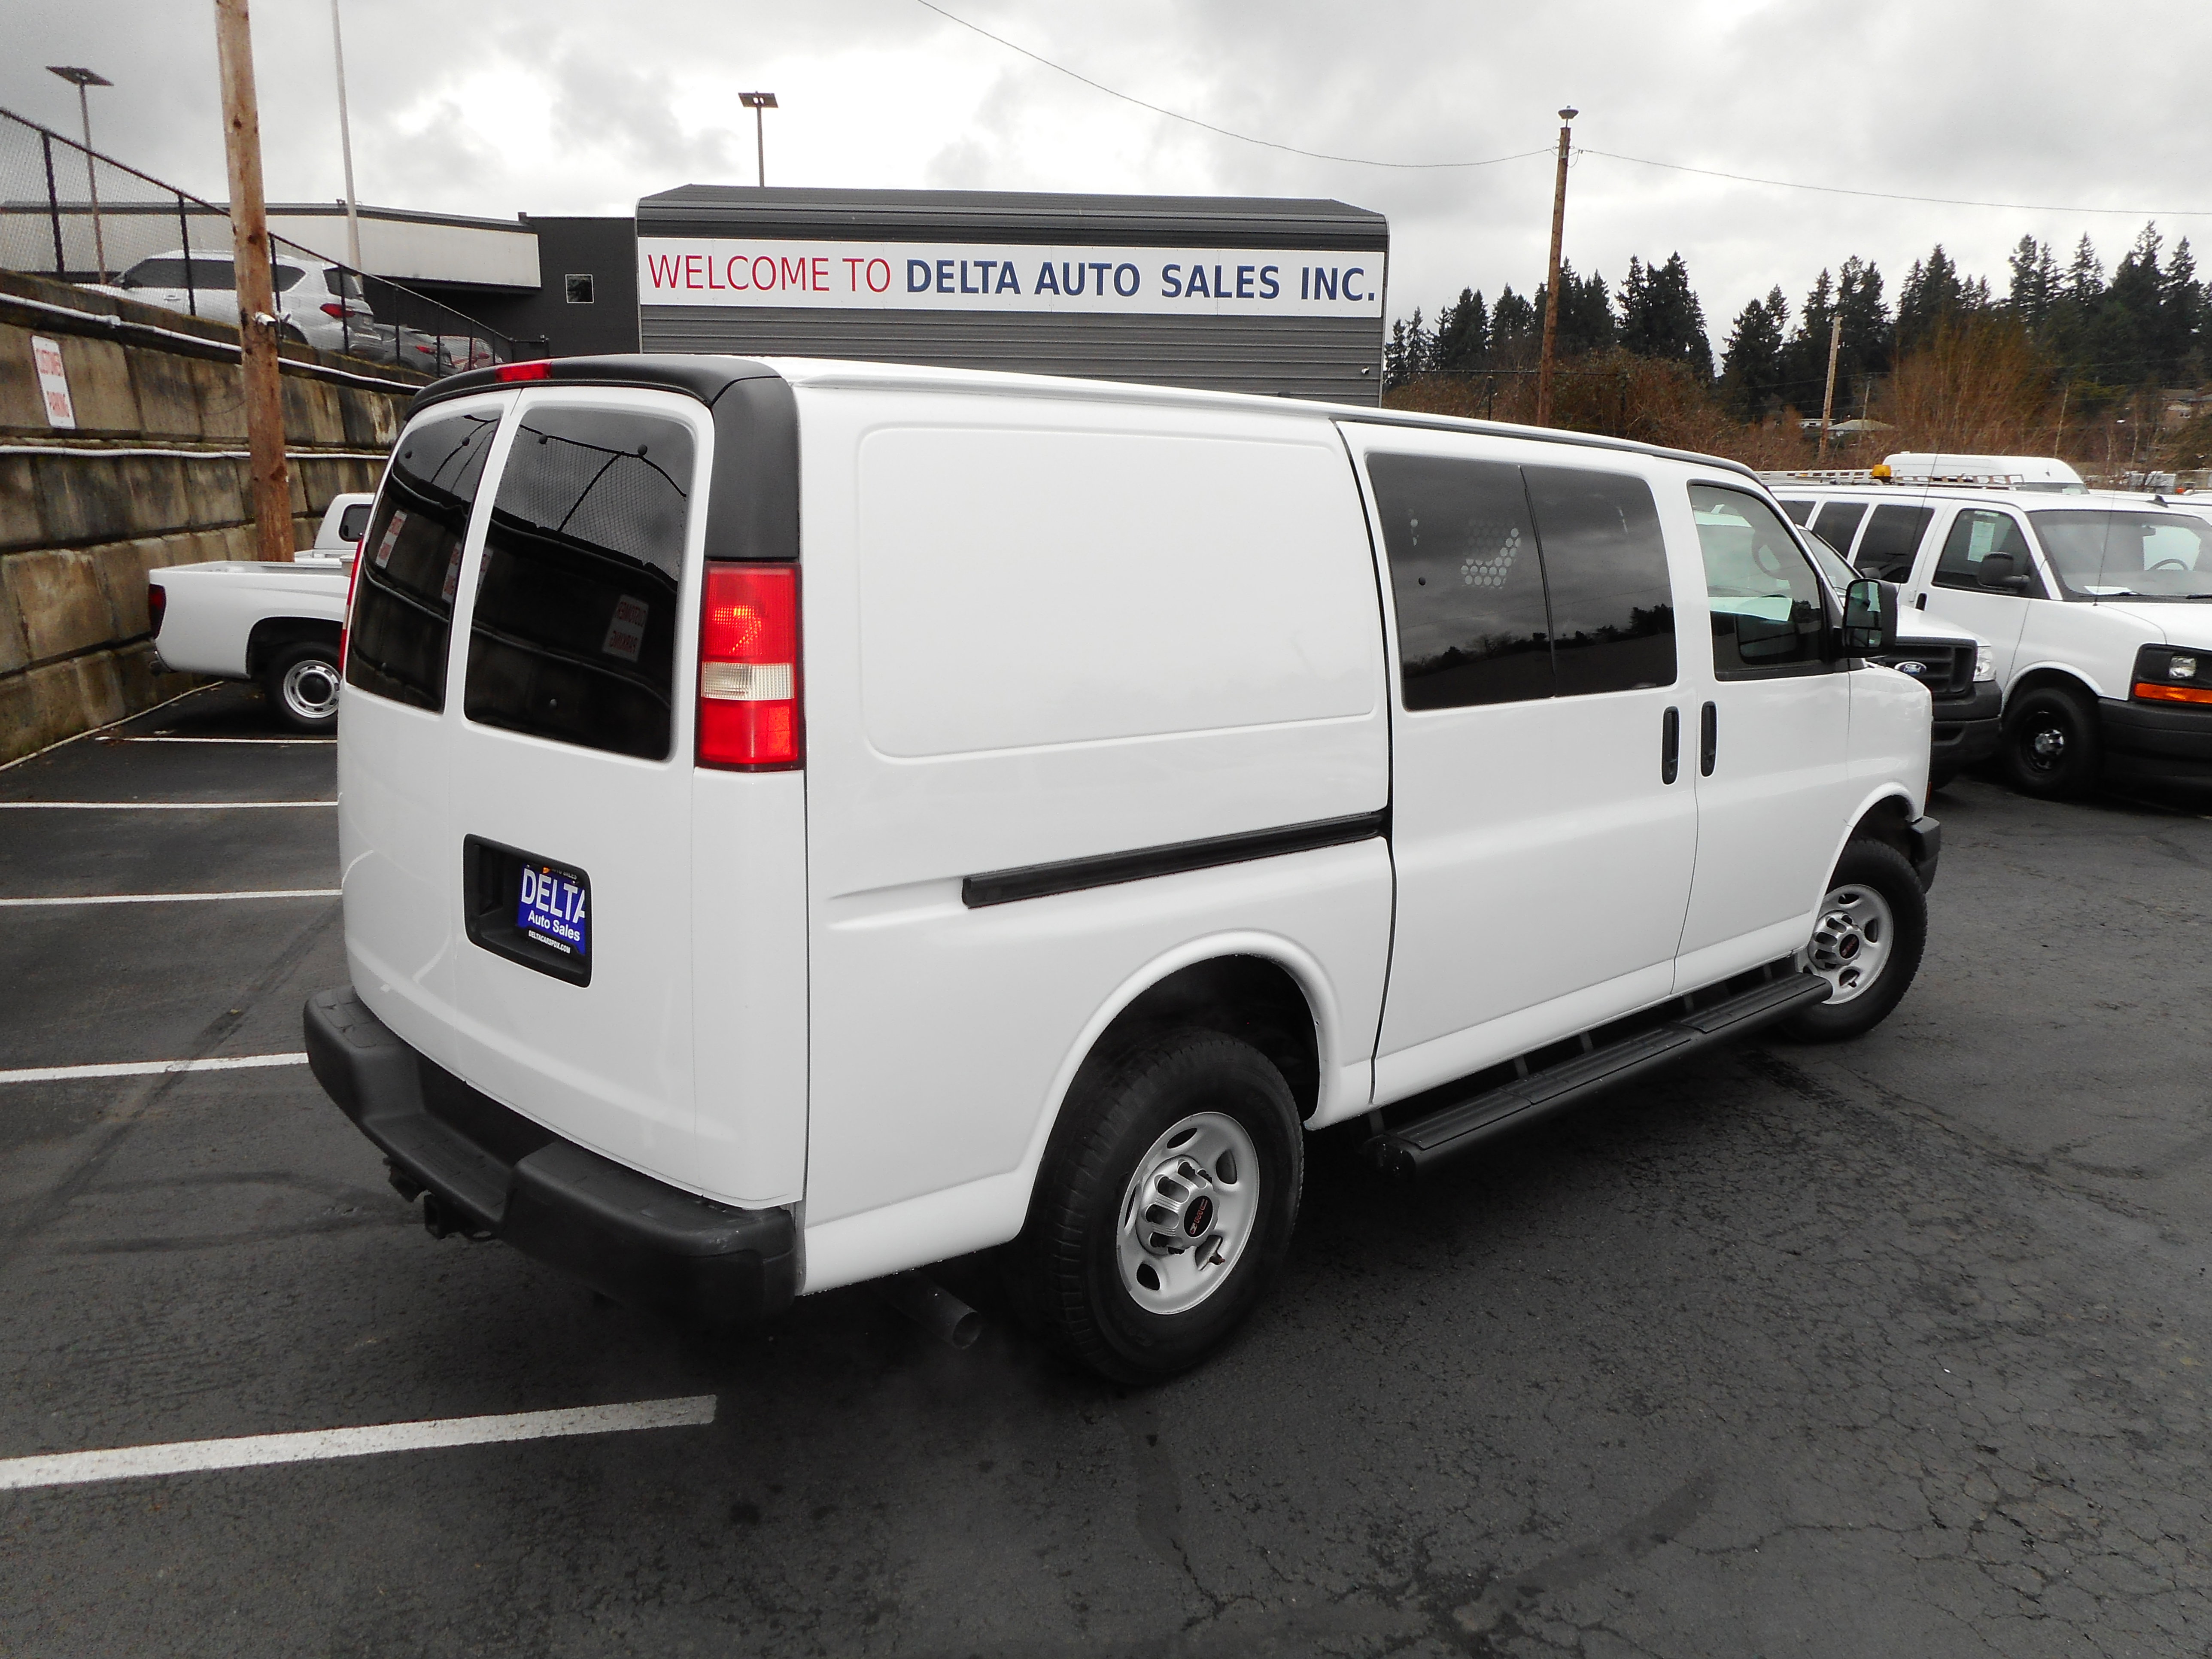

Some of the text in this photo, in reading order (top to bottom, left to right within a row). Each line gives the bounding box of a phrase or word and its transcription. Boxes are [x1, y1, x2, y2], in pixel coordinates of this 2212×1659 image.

[647, 254, 1376, 301] WELCOME TO DELTA AUTO SALES INC.
[1903, 664, 1921, 673] Ford
[521, 867, 585, 924] DELTA
[528, 910, 580, 942] Auto Sales
[1190, 1198, 1208, 1235] GMC
